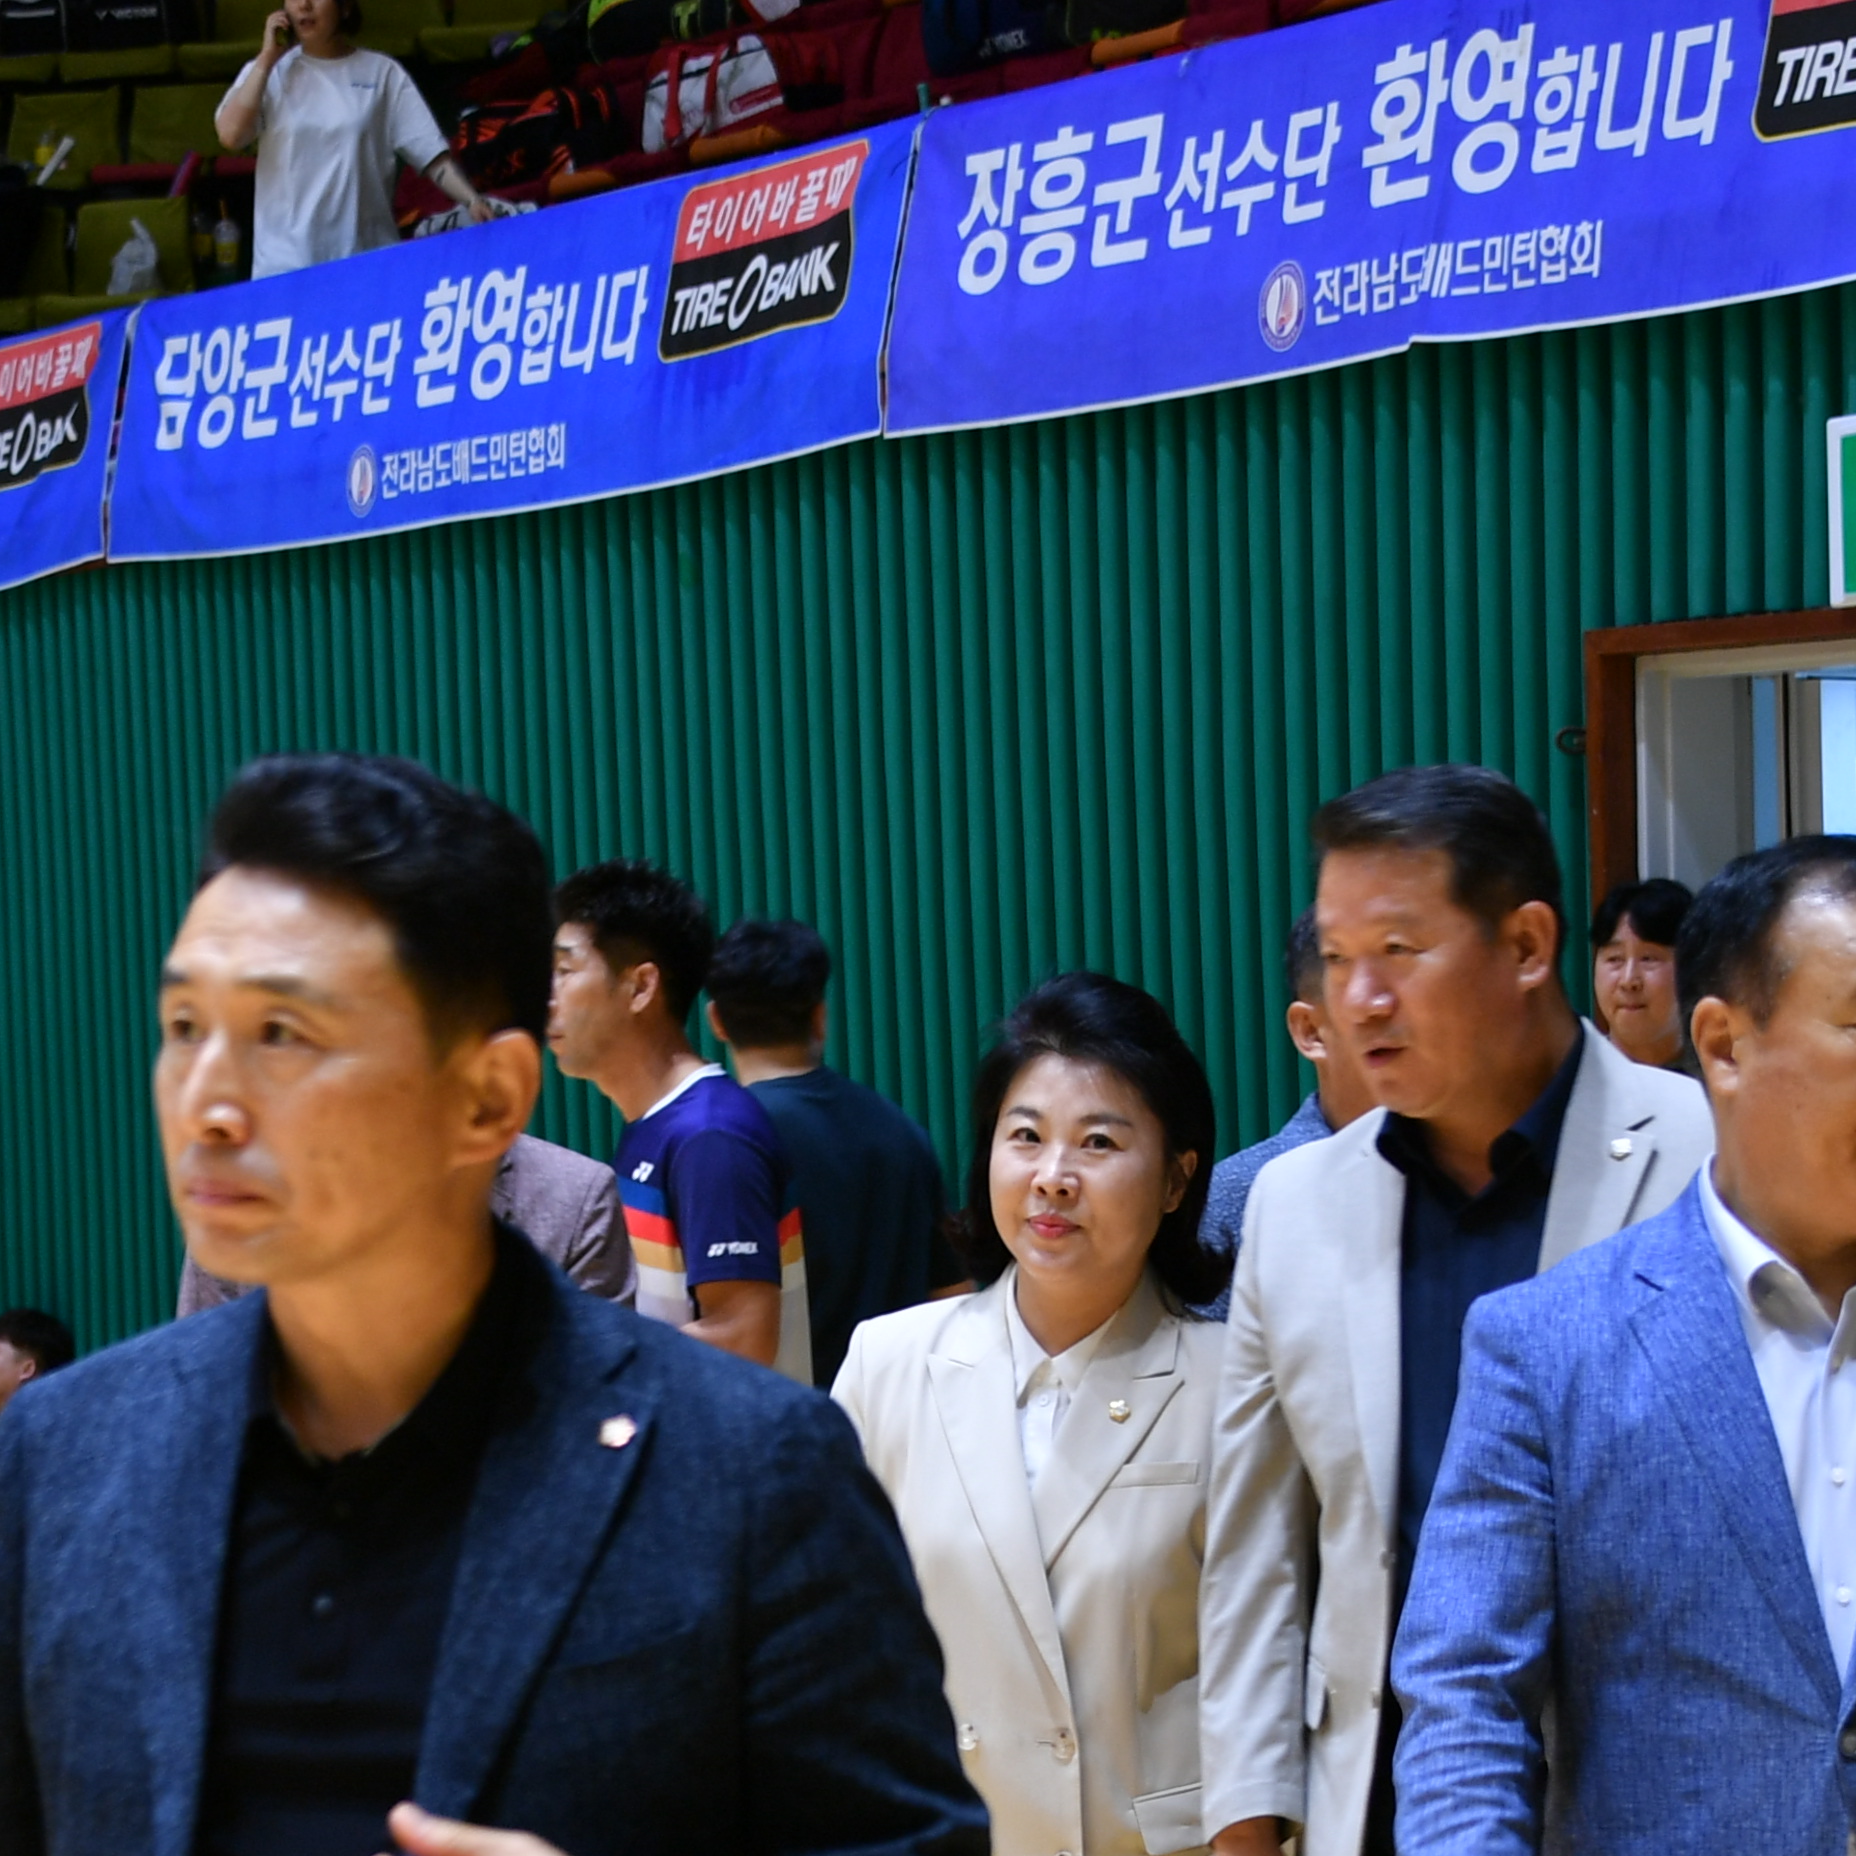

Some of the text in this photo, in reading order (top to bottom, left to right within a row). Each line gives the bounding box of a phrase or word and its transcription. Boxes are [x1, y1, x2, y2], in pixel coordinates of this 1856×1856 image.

[956, 18, 1734, 296] 장흥군 선수단 환영합니다
[671, 278, 733, 336] TIRE
[758, 242, 840, 313] BANK
[1313, 219, 1604, 325] 전라남도배드민턴협회
[154, 265, 649, 451] 담양군 선수단 환영합니다
[33, 402, 78, 461] BAK
[381, 423, 565, 500] 전라남도배드민턴협회
